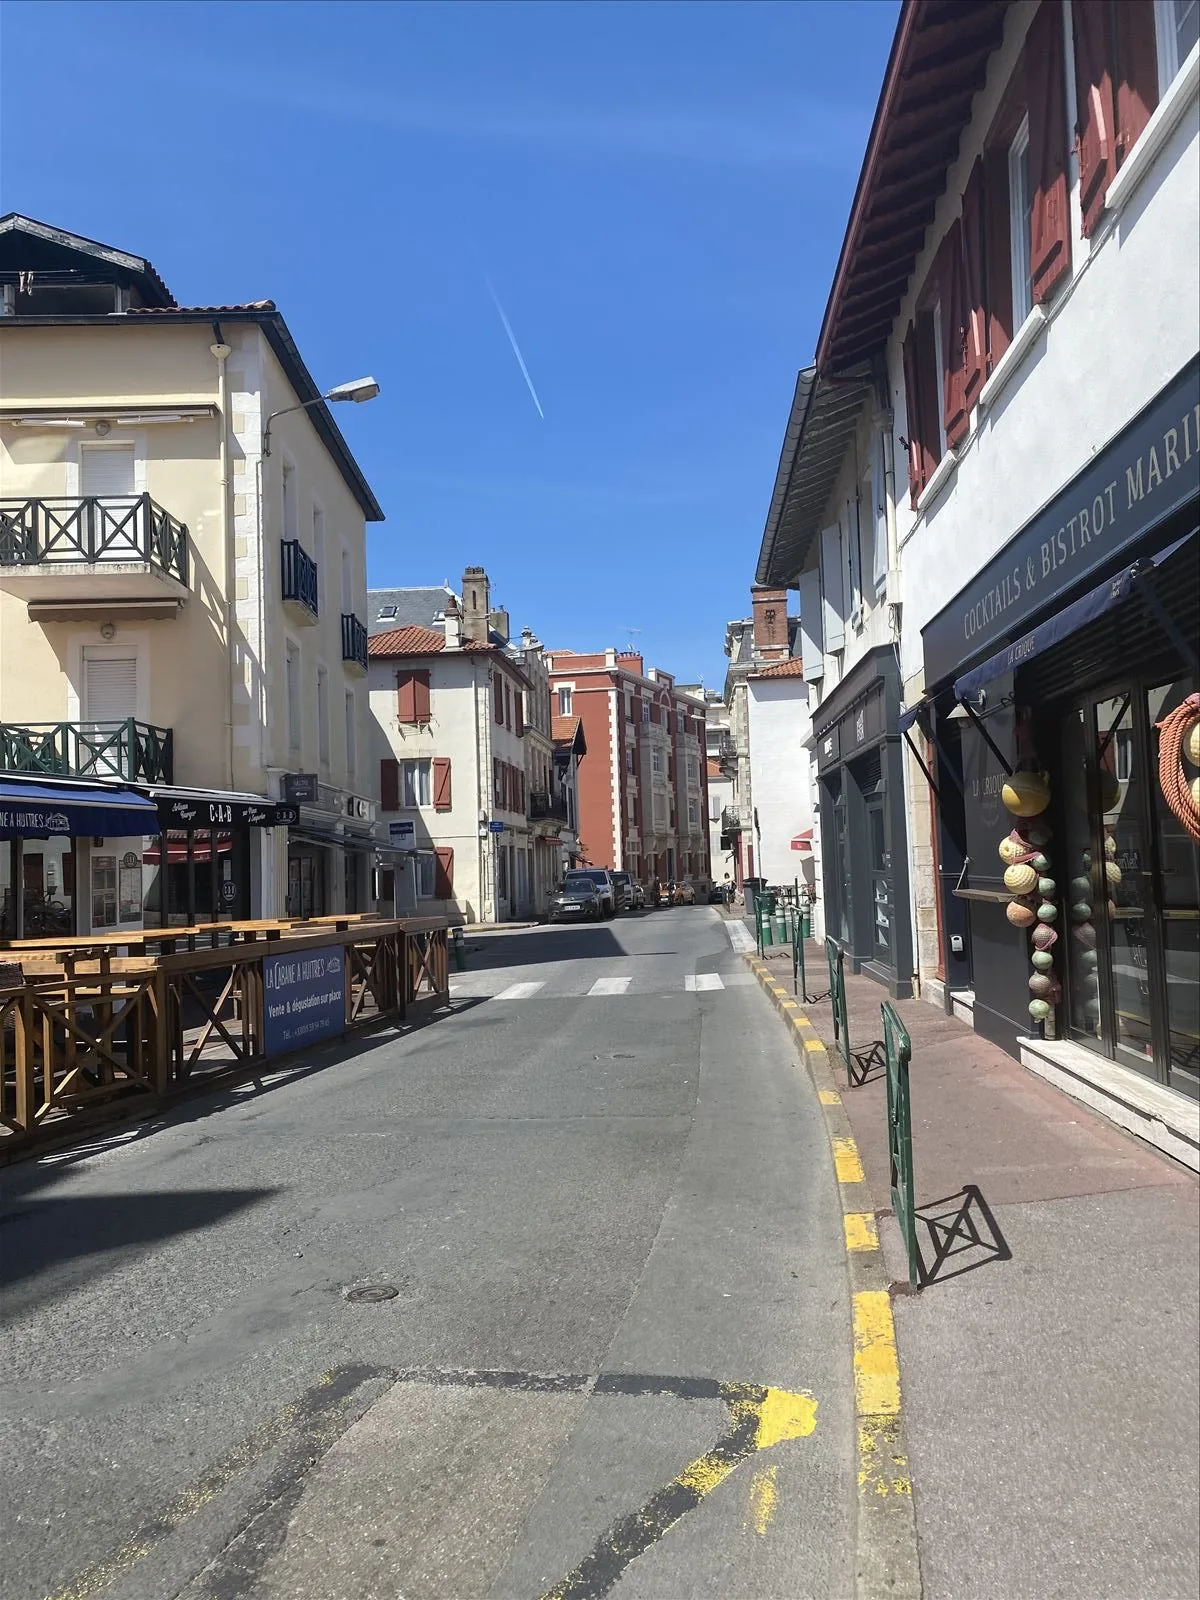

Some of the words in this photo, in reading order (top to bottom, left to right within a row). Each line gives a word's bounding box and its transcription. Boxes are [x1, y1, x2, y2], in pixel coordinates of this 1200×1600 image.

[964, 567, 1021, 640] COCKTAILS
[1025, 556, 1036, 590] &
[1041, 481, 1117, 578] BISTROT
[266, 968, 274, 989] LA
[275, 962, 295, 989] CABANE
[268, 1004, 285, 1018] Vente
[286, 1001, 291, 1013] &
[292, 994, 320, 1012] dégustation
[320, 994, 328, 1004] sur
[329, 990, 342, 1004] place
